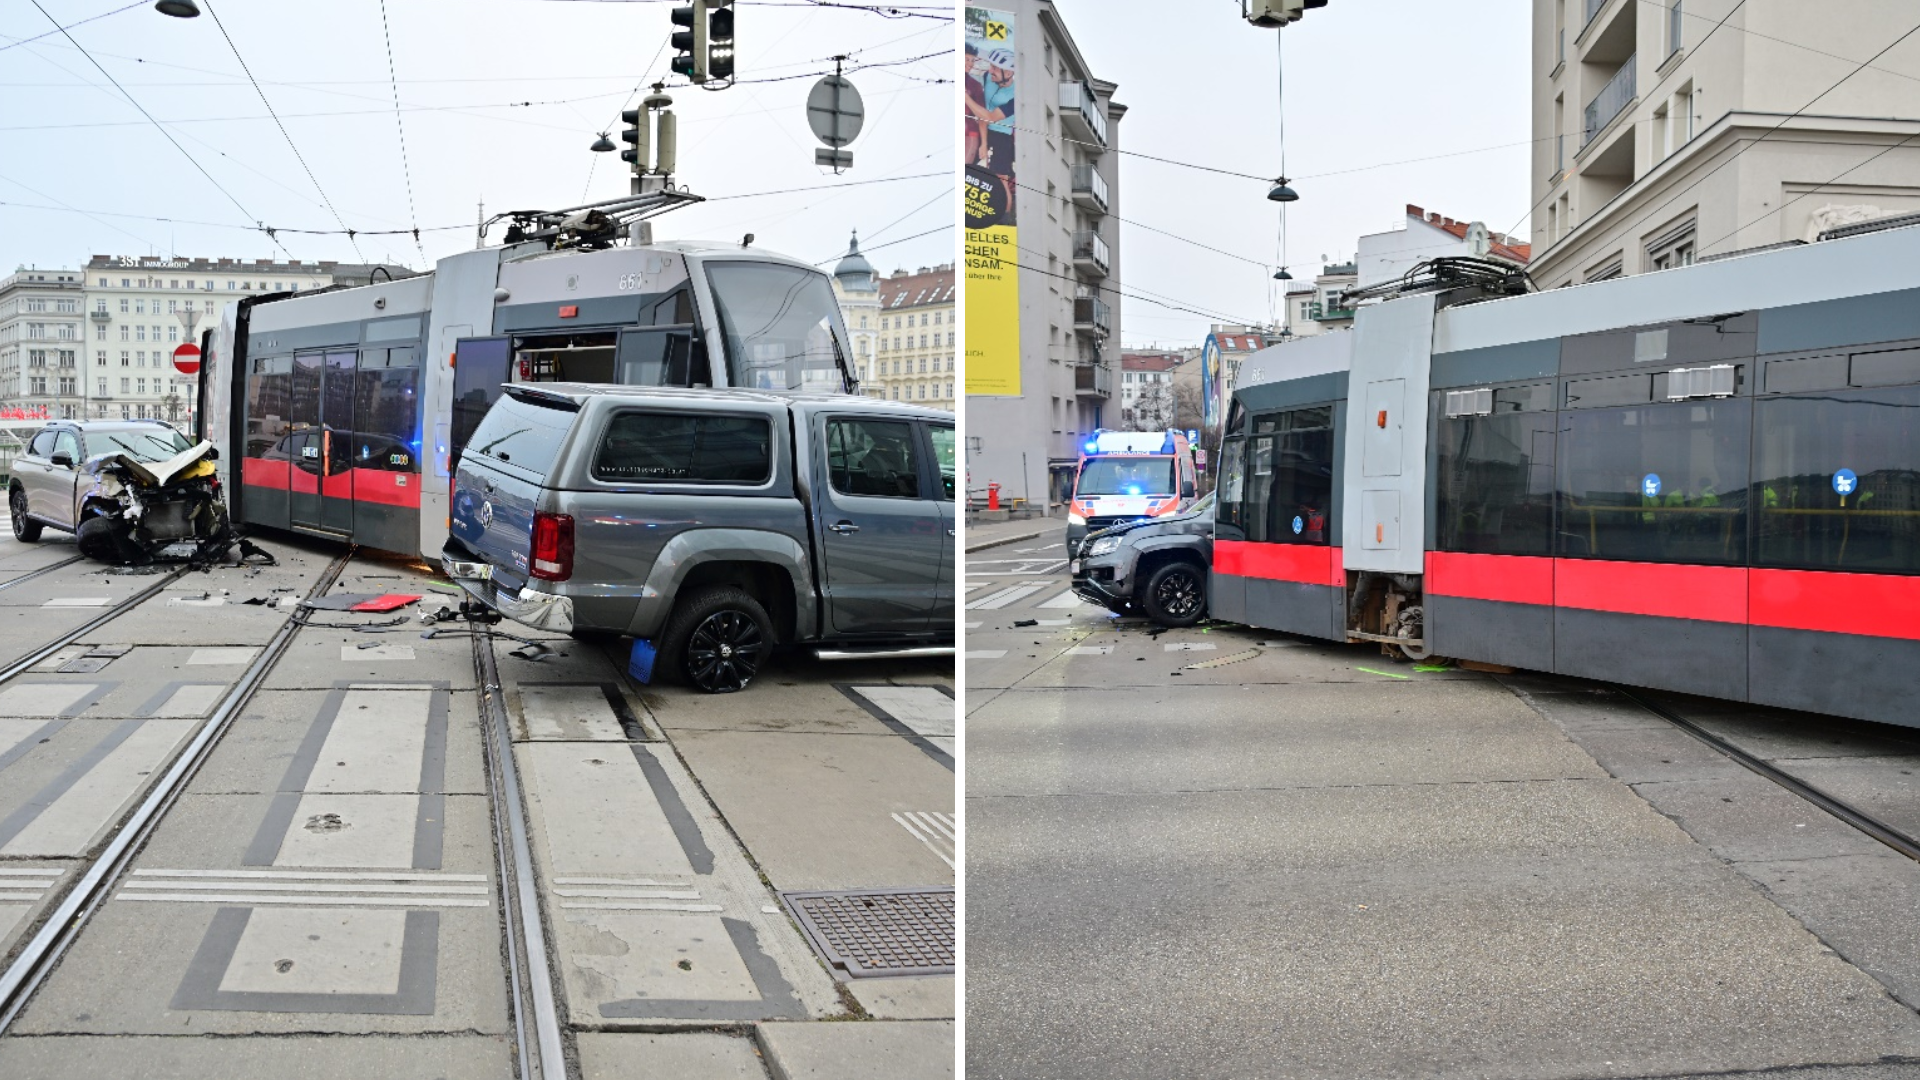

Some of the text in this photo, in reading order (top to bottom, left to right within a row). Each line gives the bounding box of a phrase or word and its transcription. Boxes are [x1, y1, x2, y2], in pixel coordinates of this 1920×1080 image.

[965, 175, 993, 192] BIS ZU
[980, 192, 990, 203] €
[965, 232, 1009, 244] IELLES
[620, 272, 642, 290] 661
